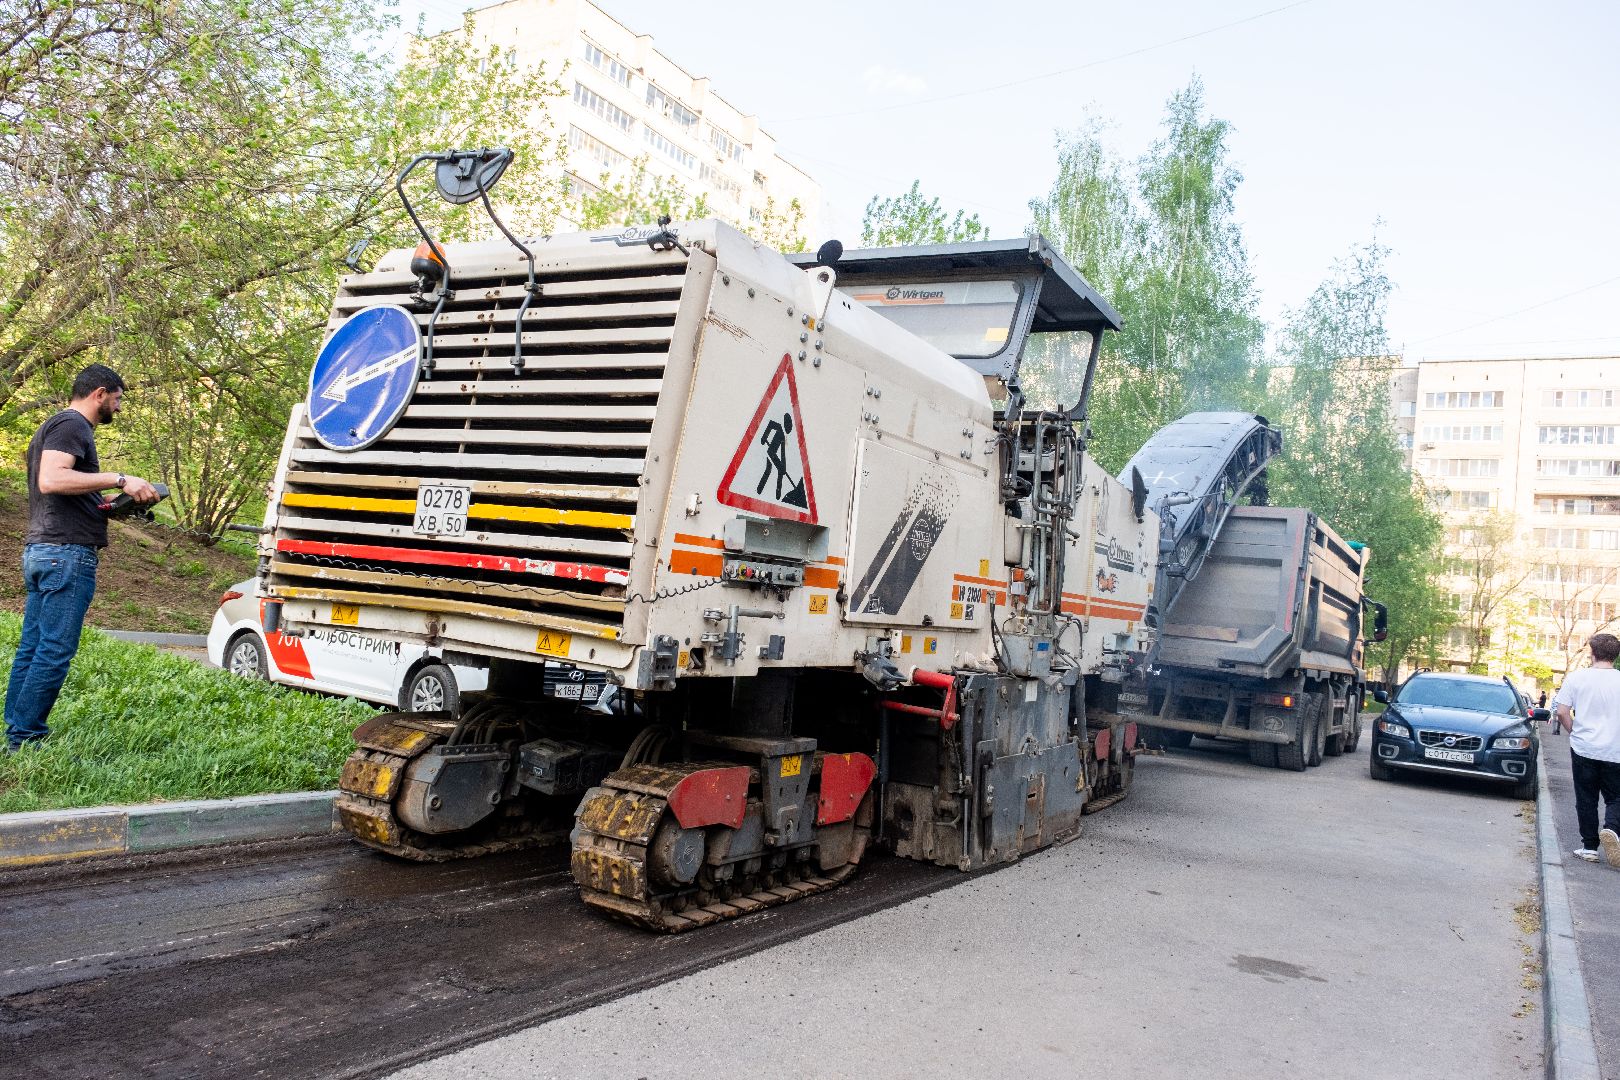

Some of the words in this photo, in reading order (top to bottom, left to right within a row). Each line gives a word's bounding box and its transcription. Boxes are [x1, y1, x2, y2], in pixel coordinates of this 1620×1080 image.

[902, 289, 944, 300] Wirtgen
[423, 488, 463, 509] 0278
[417, 515, 437, 531] ХВ
[445, 516, 462, 533] 50
